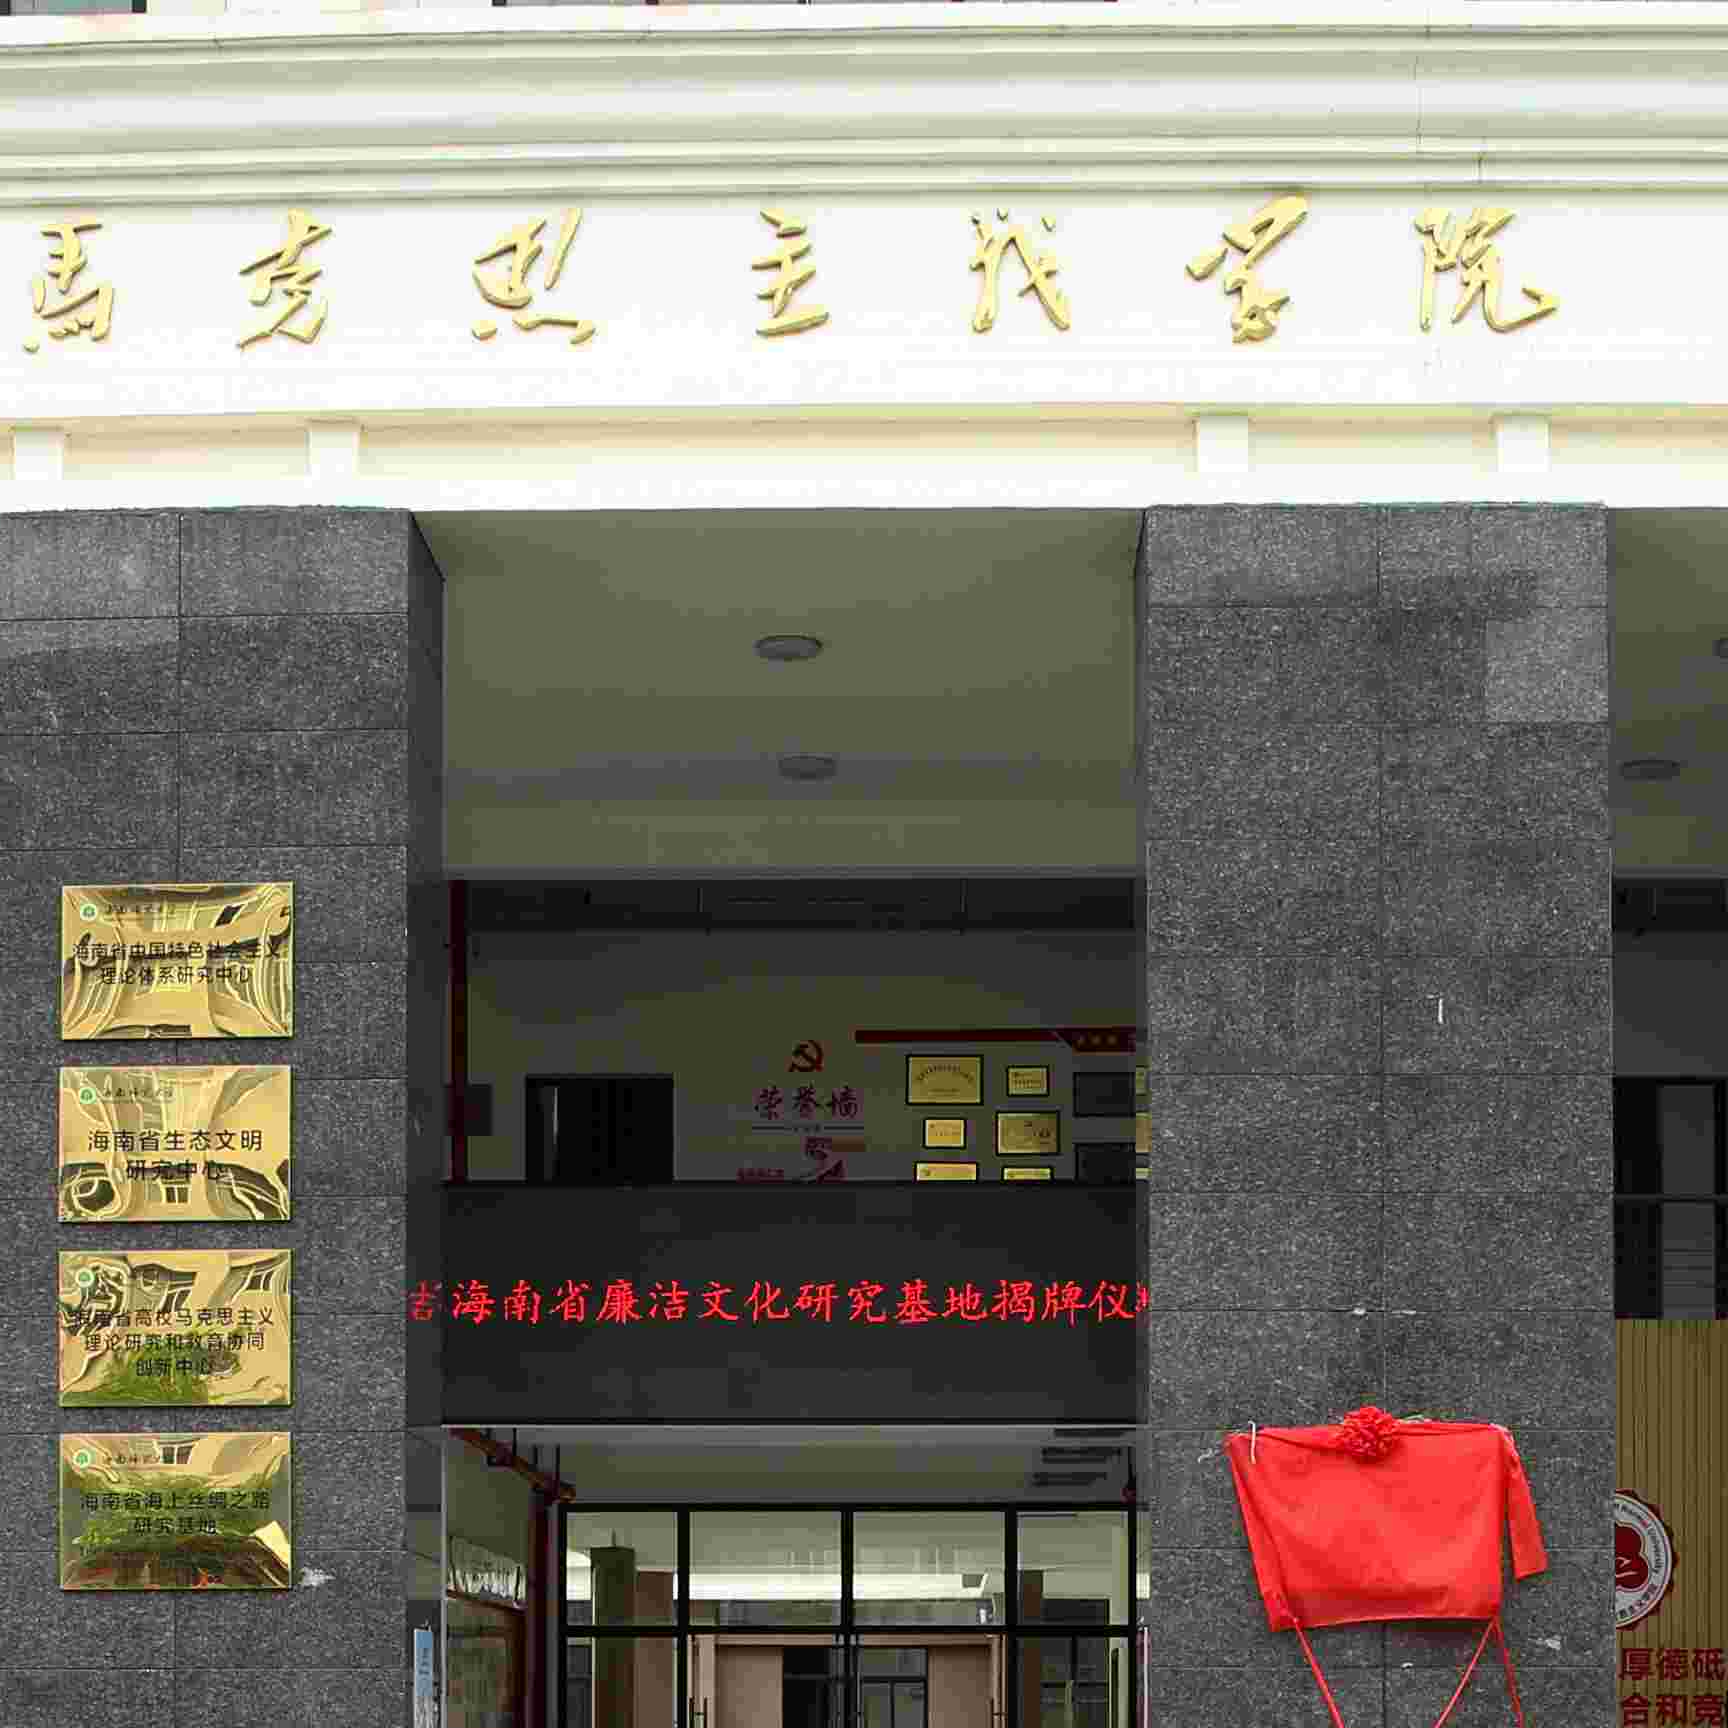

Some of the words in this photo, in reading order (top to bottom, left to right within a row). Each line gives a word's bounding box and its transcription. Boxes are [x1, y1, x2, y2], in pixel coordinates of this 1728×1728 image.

[100, 967, 251, 985] 理论体系研究中心
[88, 1129, 263, 1152] 海南省生态文明
[126, 1159, 222, 1180] 研究中心
[136, 1359, 212, 1377] 创新中心
[80, 1491, 270, 1512] 海南省海上丝绸之路
[134, 1516, 218, 1536] 研究基地
